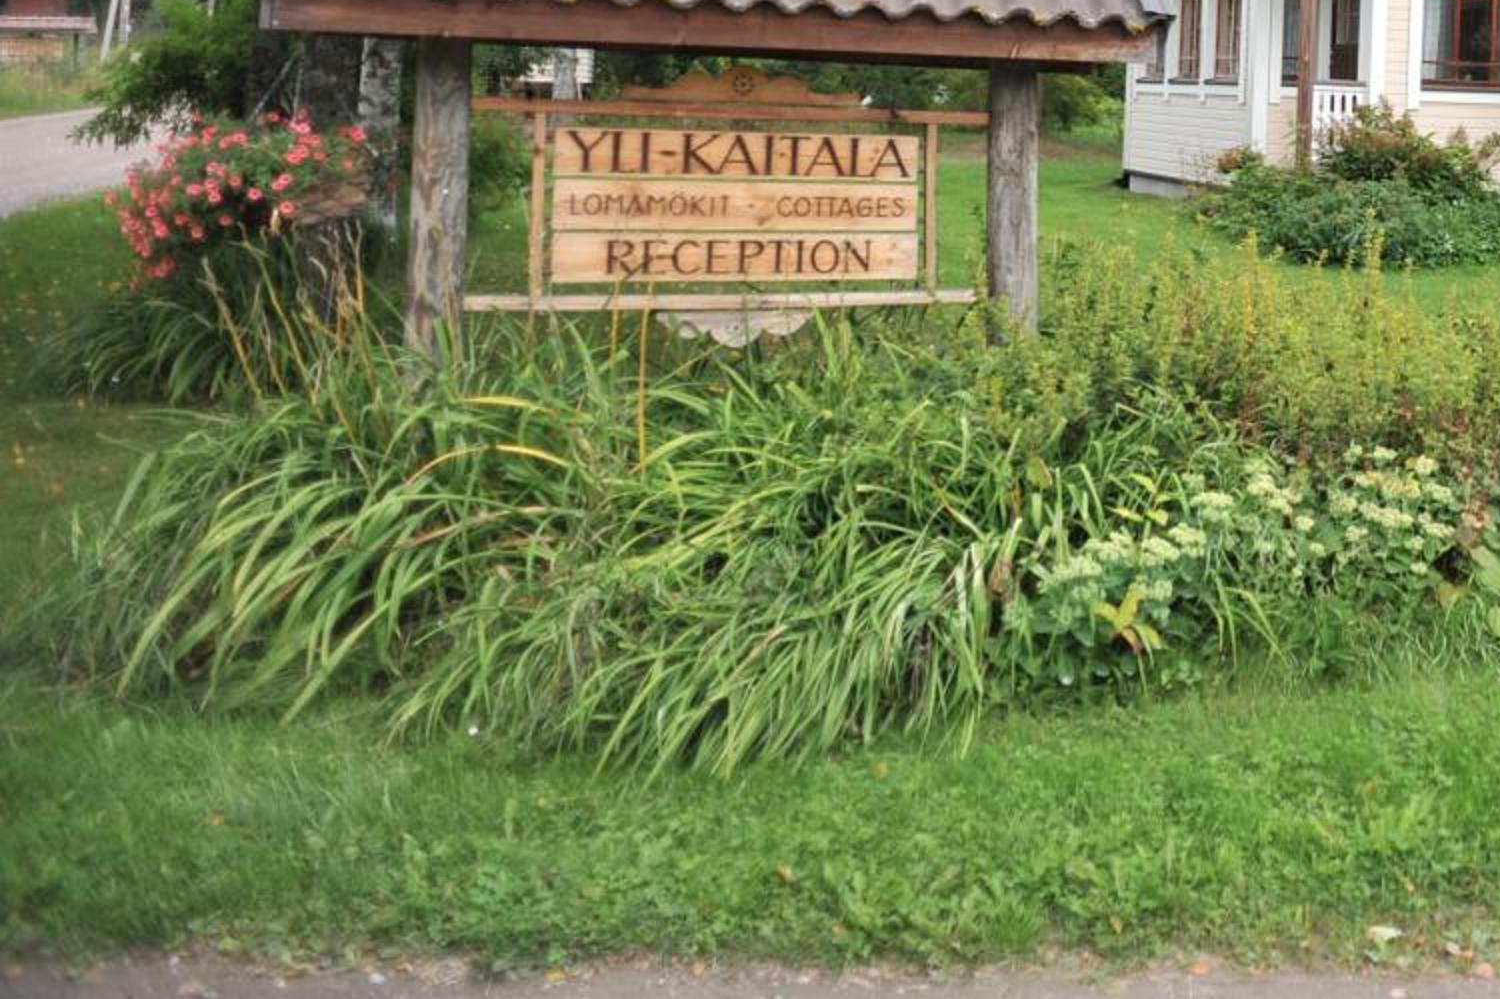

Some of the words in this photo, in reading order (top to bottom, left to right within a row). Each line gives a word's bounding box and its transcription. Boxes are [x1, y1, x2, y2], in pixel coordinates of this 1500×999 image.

[566, 130, 910, 177] YLI-KAITALA
[569, 190, 730, 218] LOMAMÖKIT
[776, 196, 906, 218] COTTAGES
[605, 239, 872, 275] RECEPTION
